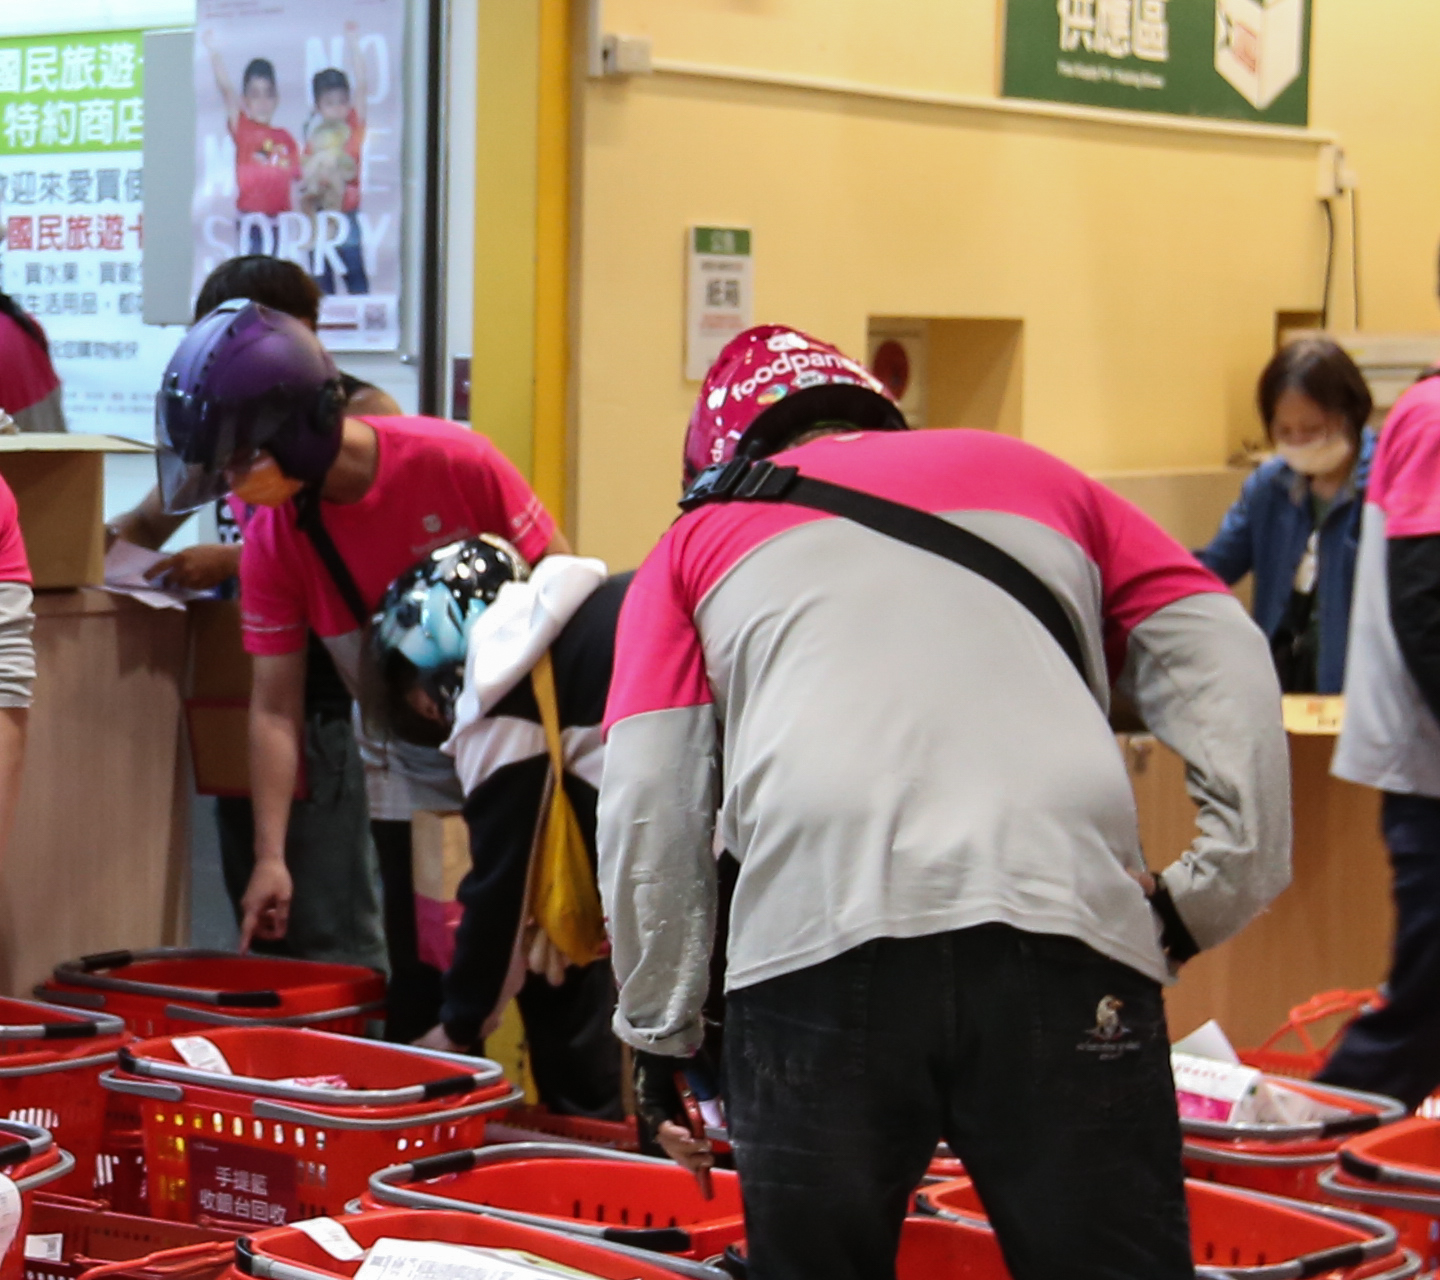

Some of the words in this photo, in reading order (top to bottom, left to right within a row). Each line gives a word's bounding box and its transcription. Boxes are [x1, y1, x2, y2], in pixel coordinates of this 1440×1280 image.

[203, 210, 391, 277] SORRY
[215, 1165, 269, 1197] 手提籃
[199, 1189, 287, 1225] 收銀台回收
